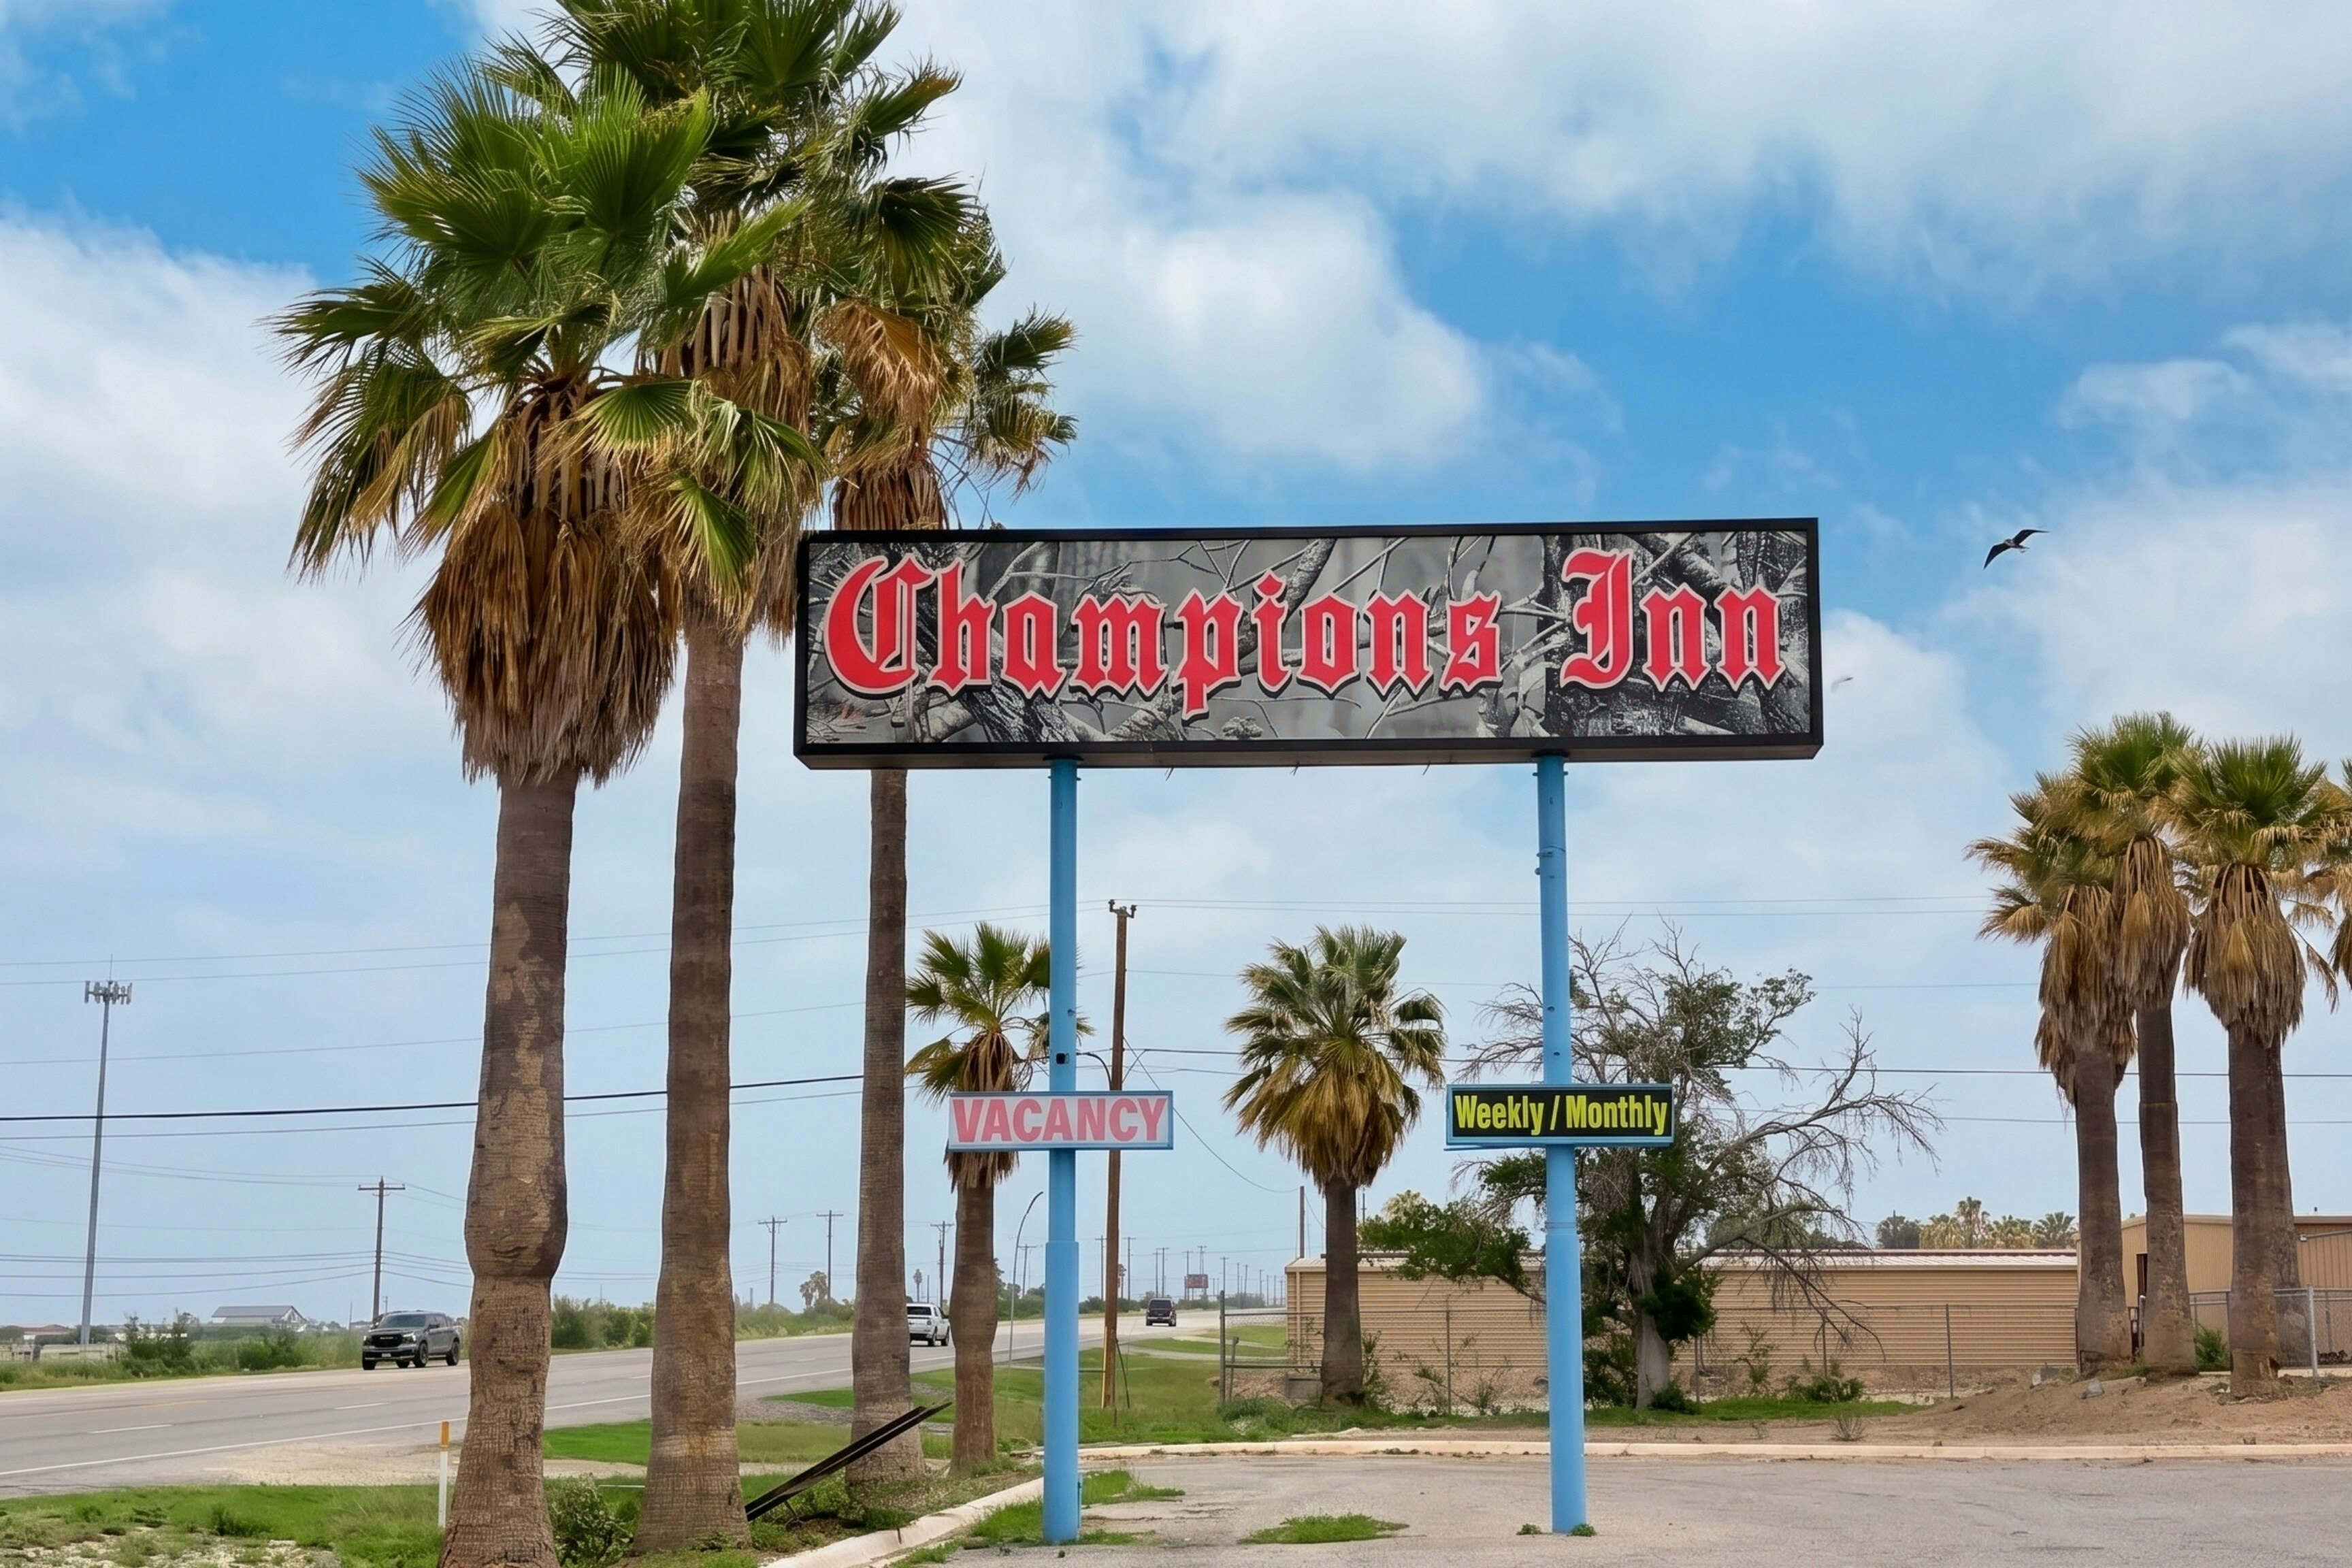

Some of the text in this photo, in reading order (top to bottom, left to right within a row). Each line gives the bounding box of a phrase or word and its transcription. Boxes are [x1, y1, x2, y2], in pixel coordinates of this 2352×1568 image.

[824, 547, 1787, 720] Champions Inn
[952, 1098, 1167, 1142] VACANCY
